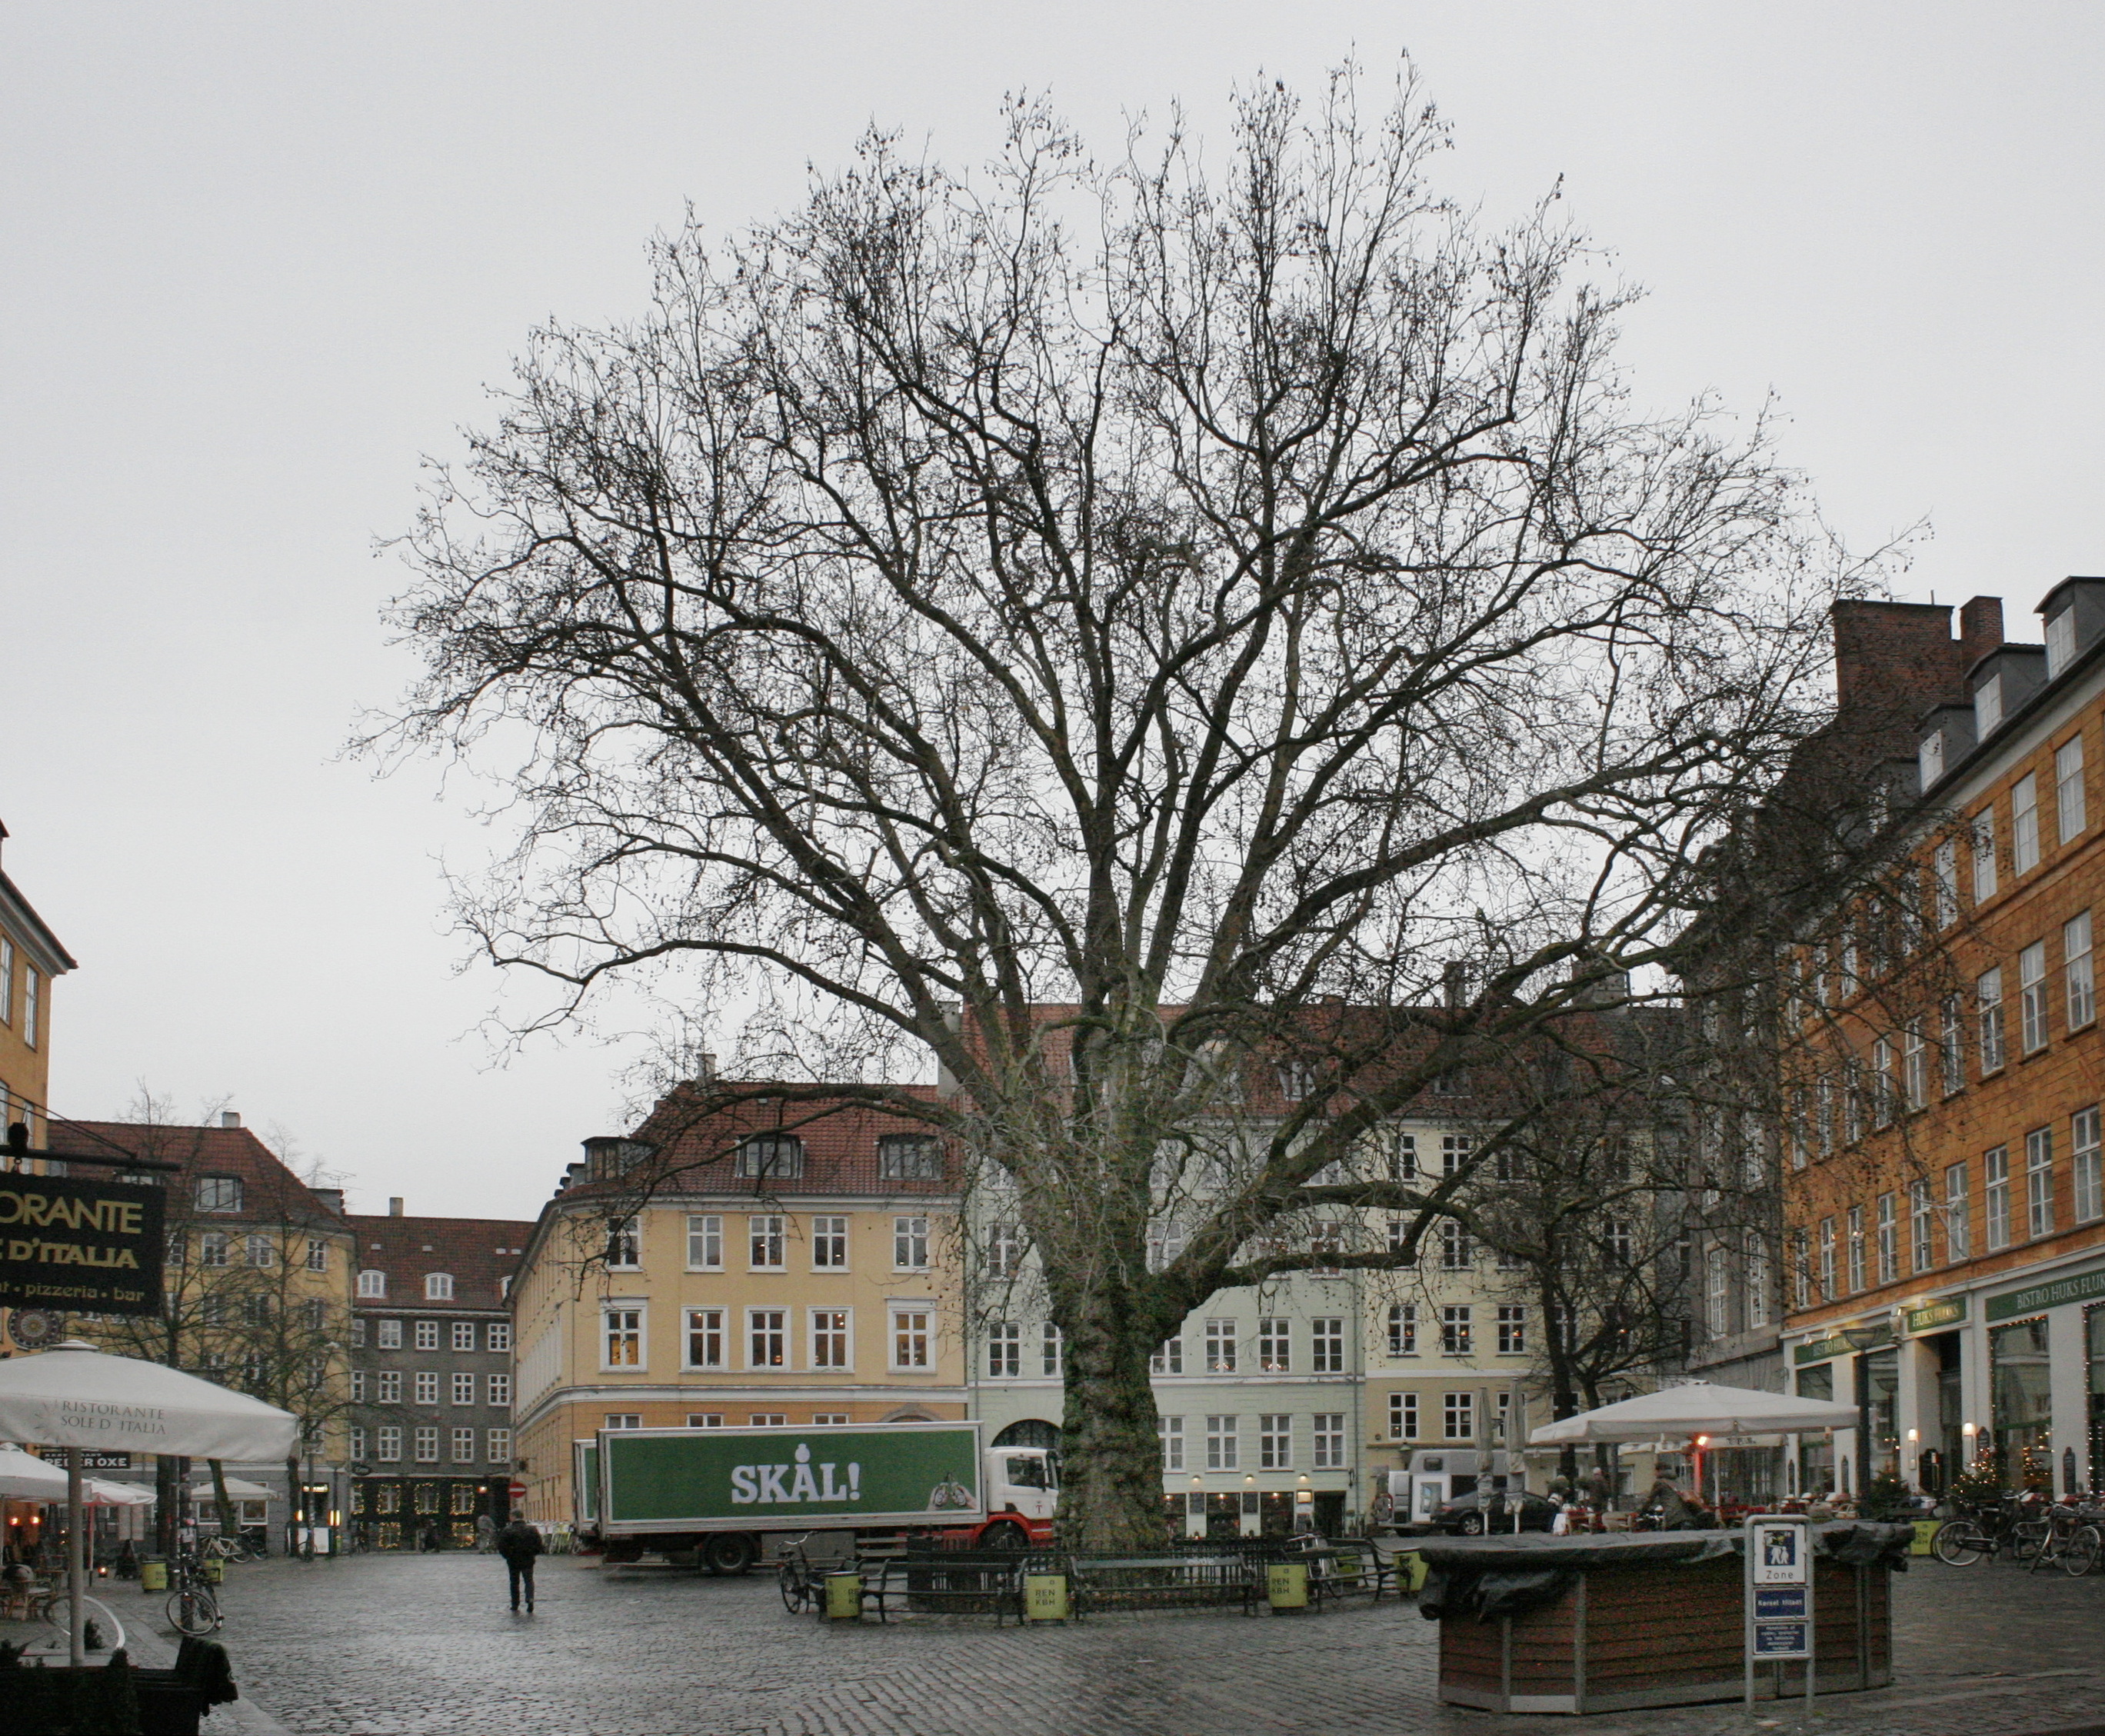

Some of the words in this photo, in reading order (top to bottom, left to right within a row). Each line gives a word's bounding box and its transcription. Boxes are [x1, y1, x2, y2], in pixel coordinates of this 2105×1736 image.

[8, 1238, 140, 1269] D'ITALIA
[25, 1282, 98, 1298] pizzeria
[114, 1287, 145, 1301] bar
[2017, 1288, 2049, 1309] BISTRO
[2051, 1280, 2078, 1301] HUKS
[1913, 1309, 1933, 1327] HUKS
[62, 1401, 165, 1420] RISTORANTE
[61, 1415, 95, 1428] SOLE
[121, 1420, 166, 1434] ITALIA
[97, 1458, 127, 1467] OXE
[731, 1443, 860, 1504] SKÅL!
[1766, 1571, 1794, 1579] Zone
